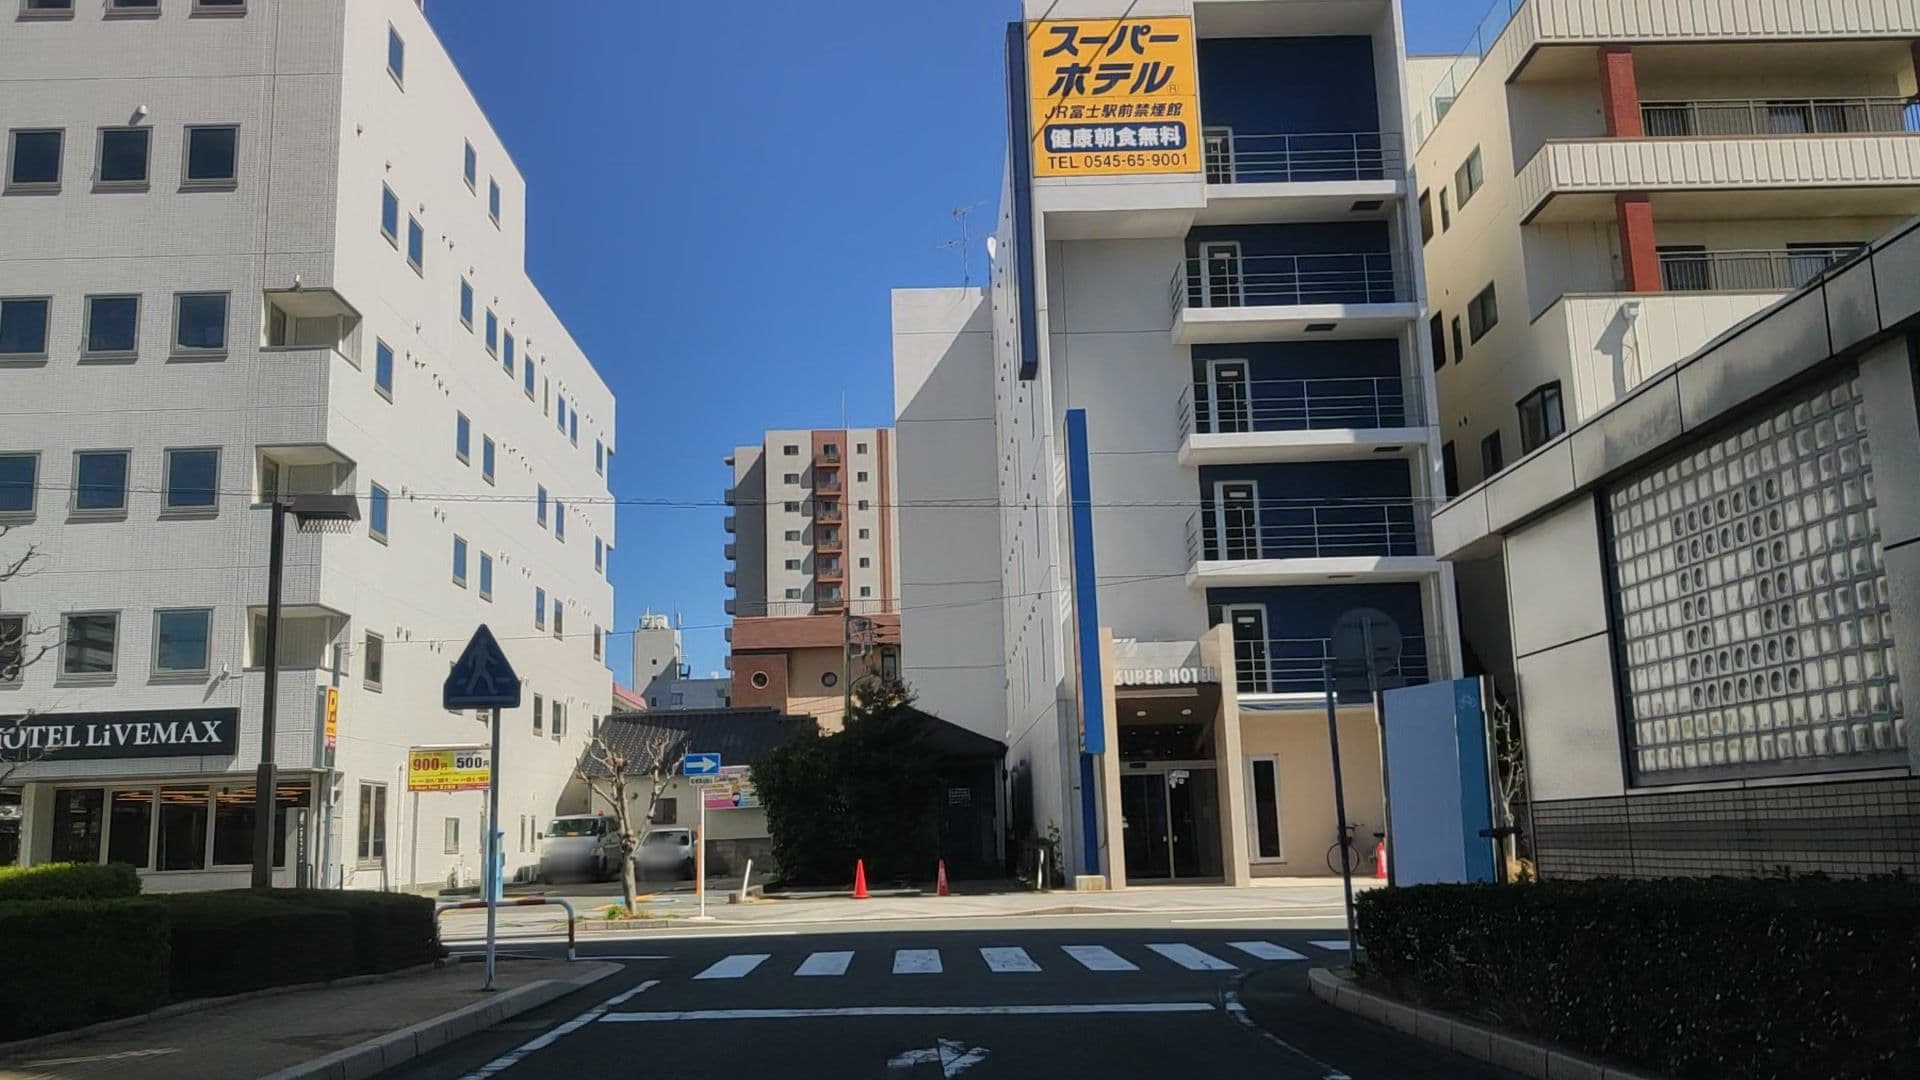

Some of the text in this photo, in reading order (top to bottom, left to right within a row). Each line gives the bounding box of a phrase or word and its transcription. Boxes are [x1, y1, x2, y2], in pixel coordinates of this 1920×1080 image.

[1043, 24, 1180, 57] スーパー
[1047, 61, 1175, 98] ホテル
[1045, 102, 1183, 119] JR富士駅前禁煙館
[1050, 125, 1181, 149] 健康朝食無料
[1048, 153, 1188, 169] TEL 0545-65-9001
[1114, 667, 1217, 686] SUPER HOTEL
[0, 720, 223, 749] OTEL LiVEMAX
